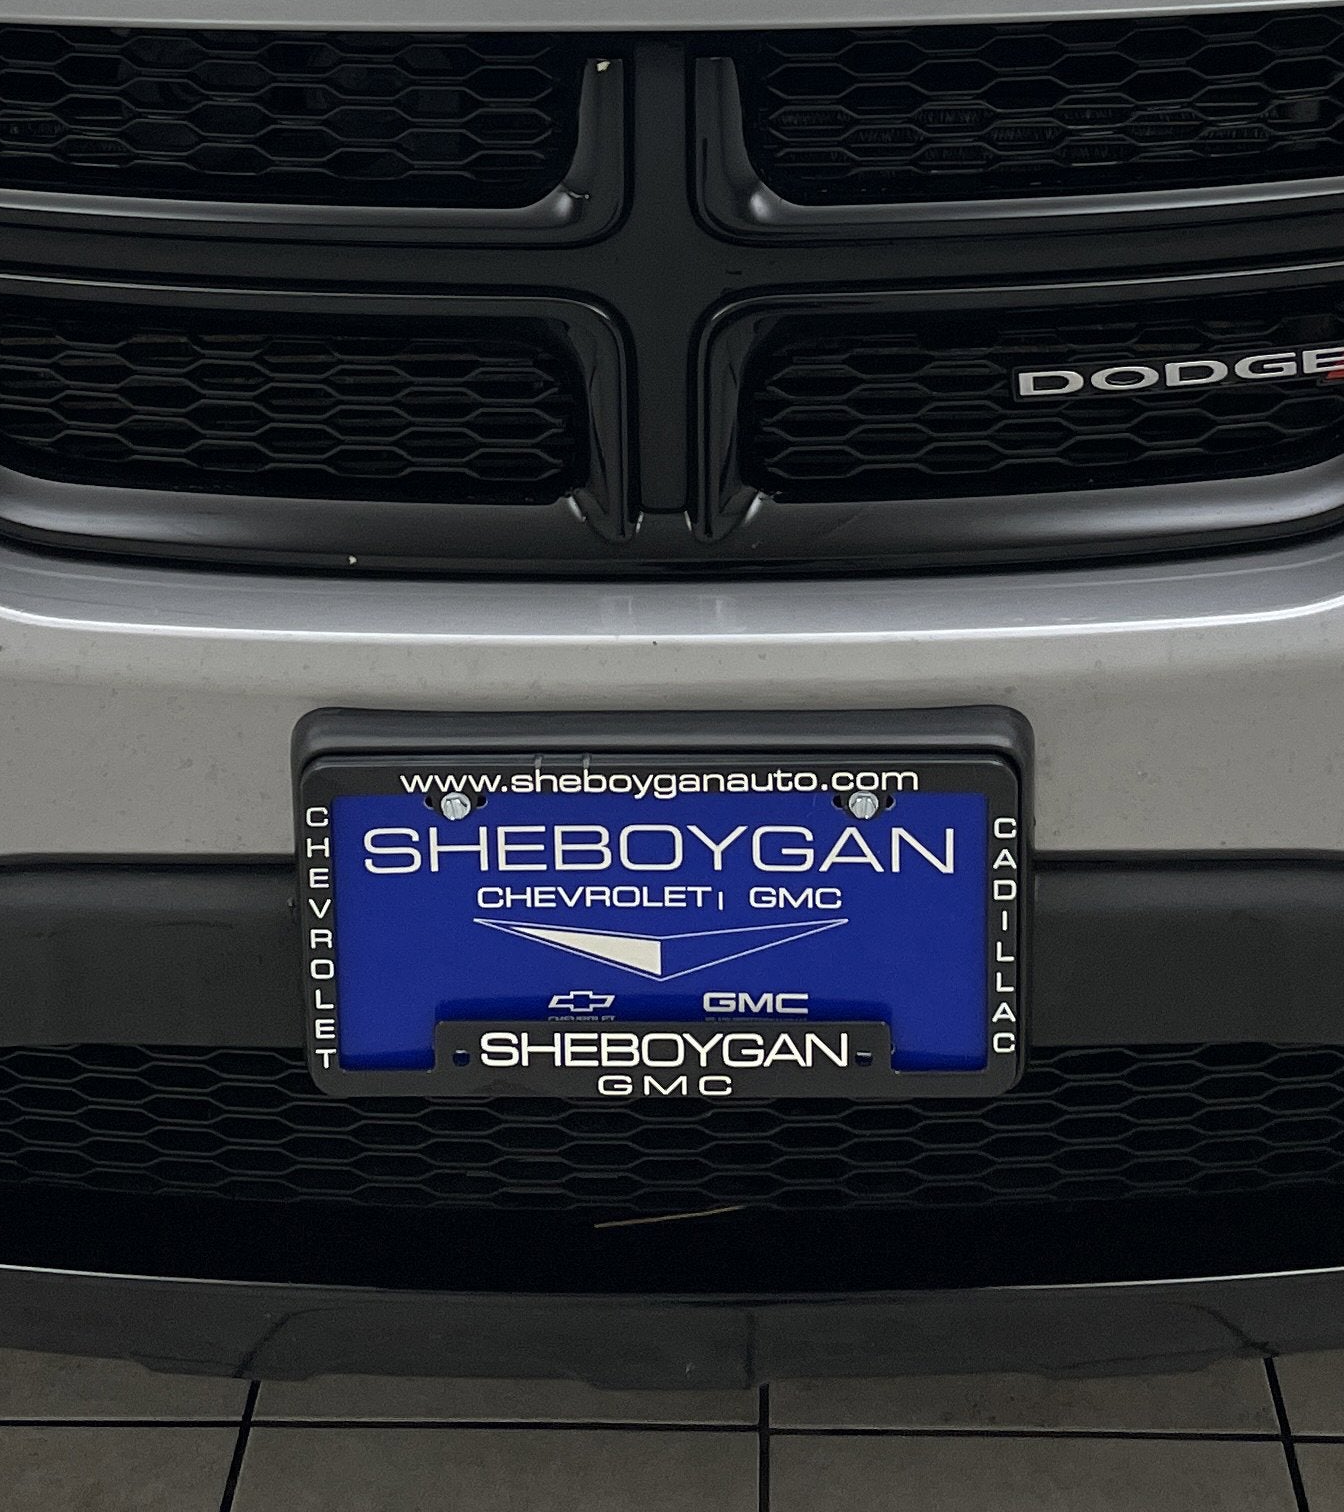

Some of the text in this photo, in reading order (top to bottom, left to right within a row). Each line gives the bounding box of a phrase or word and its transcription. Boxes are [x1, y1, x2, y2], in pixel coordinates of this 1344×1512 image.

[399, 768, 919, 800] www.sheboyganauto.com
[363, 824, 954, 874] SHEBOYGAN
[477, 886, 842, 909] CHEVROLET GMC
[306, 806, 338, 1070] CHEVROLET
[991, 816, 1018, 1054] CADILLAC
[703, 992, 809, 1014] GMC
[480, 1032, 849, 1068] SHEBOYGAN
[597, 1075, 733, 1096] GMC
